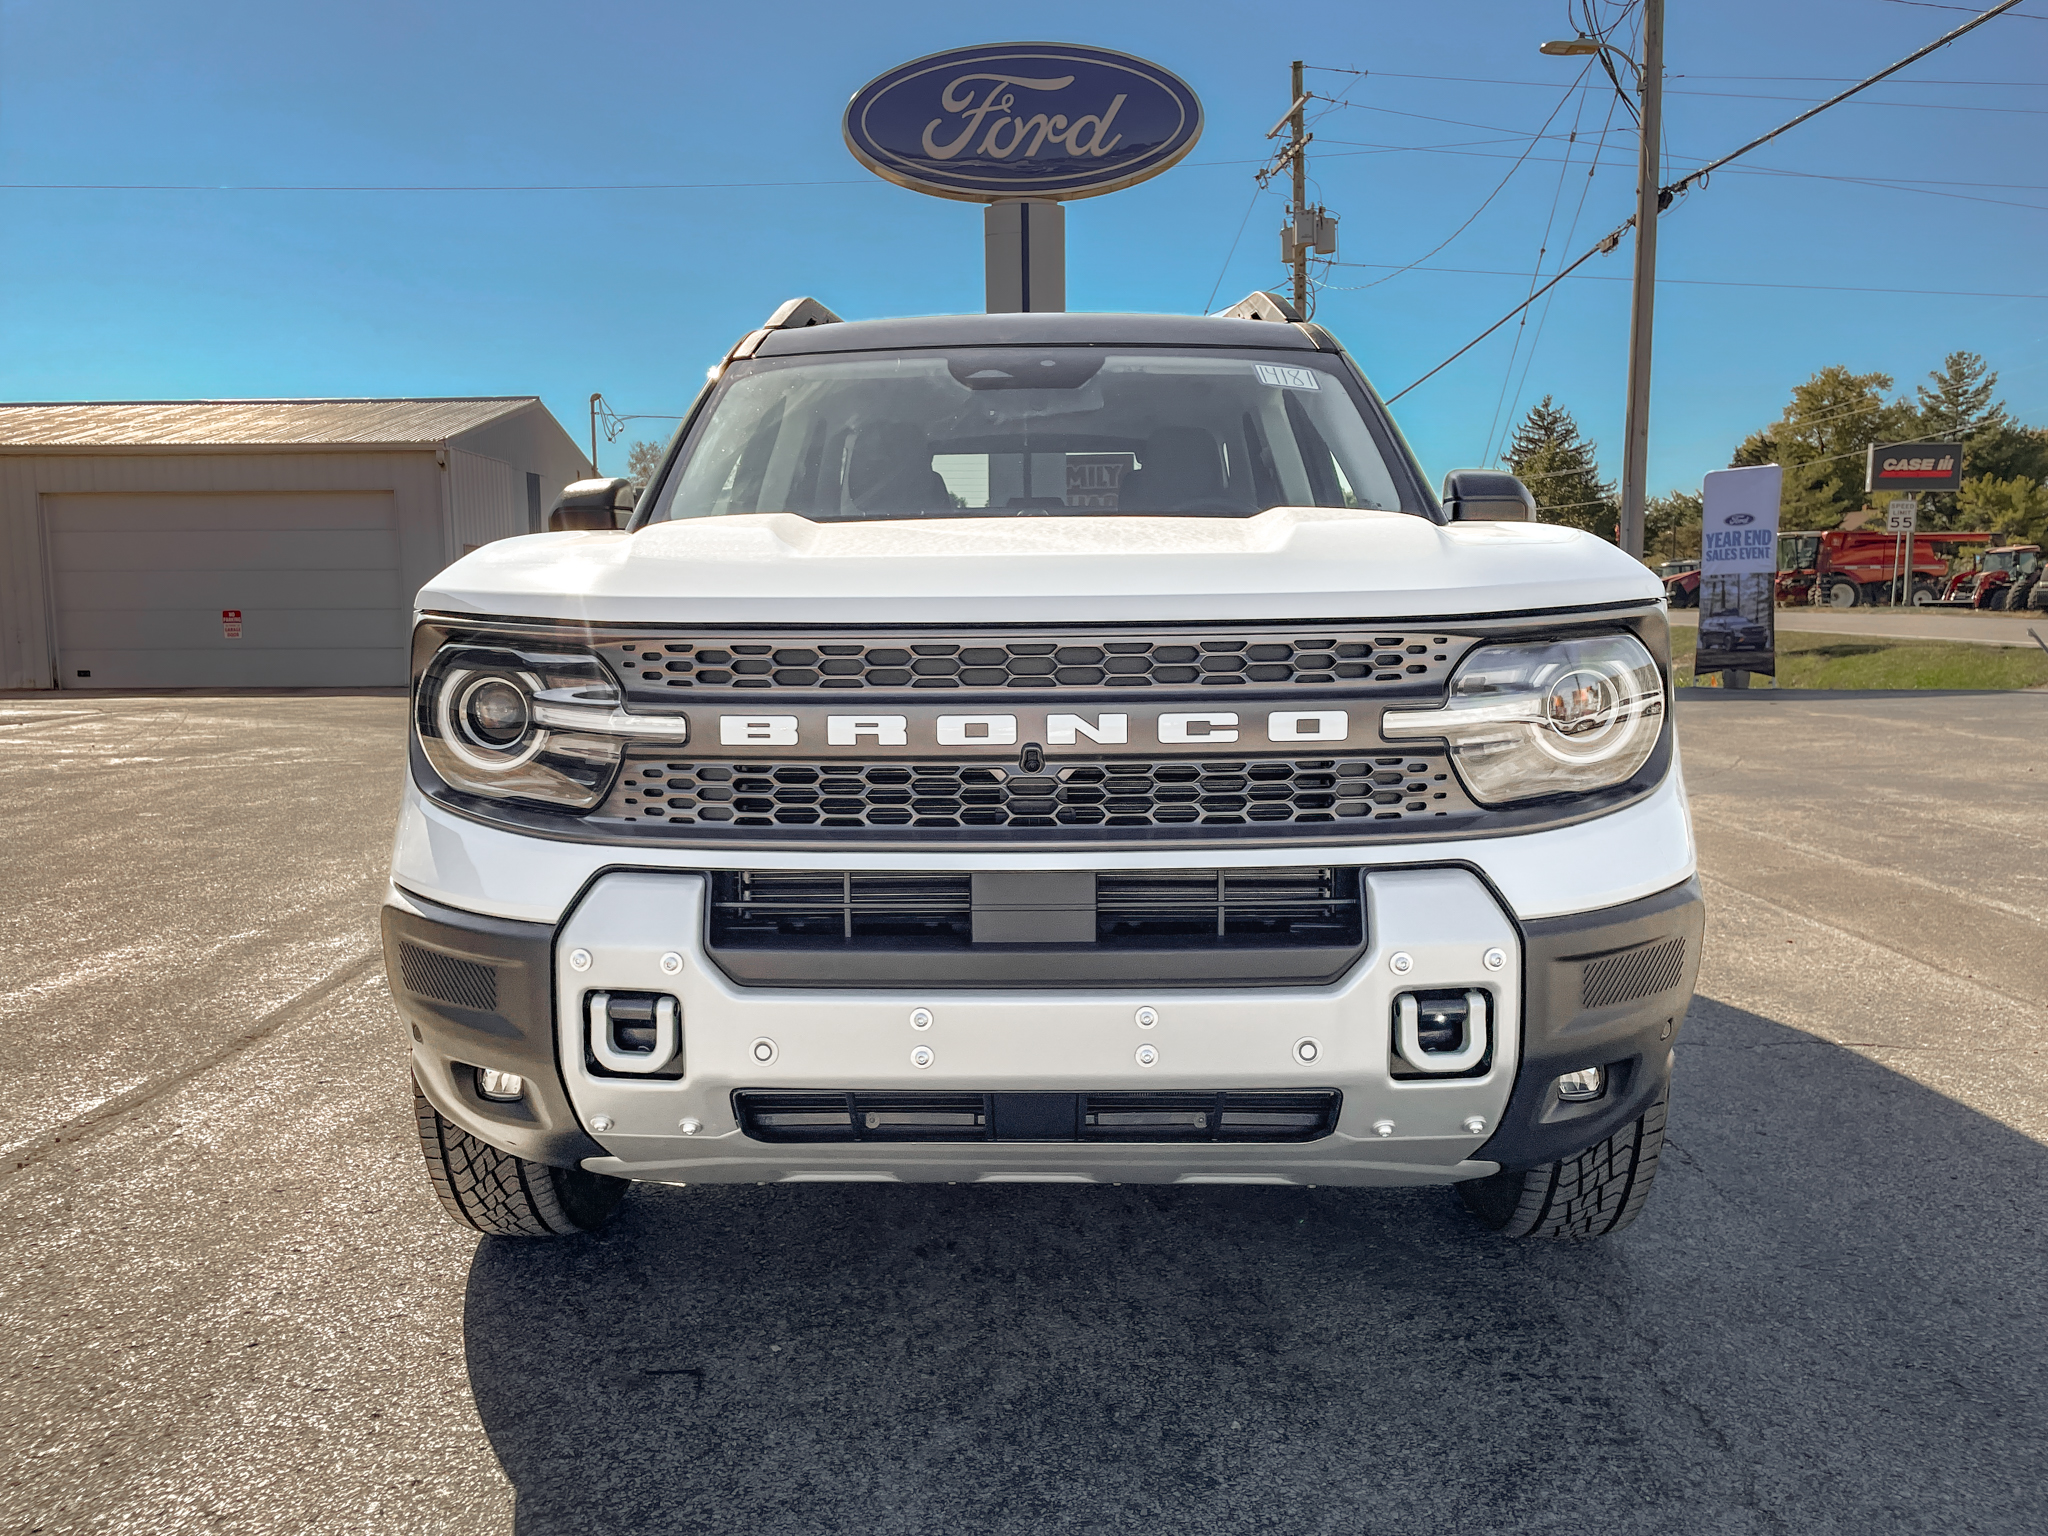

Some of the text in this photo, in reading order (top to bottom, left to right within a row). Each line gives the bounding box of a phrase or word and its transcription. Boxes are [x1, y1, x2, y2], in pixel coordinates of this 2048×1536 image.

[922, 73, 1128, 159] Ford
[1258, 365, 1314, 387] 14181
[1883, 458, 1935, 471] CASE
[1728, 515, 1751, 526] Ford
[1890, 517, 1912, 529] 55
[1705, 529, 1772, 549] YEAR END
[1705, 547, 1771, 562] SALES EVENT
[720, 711, 1349, 746] BRONCO
